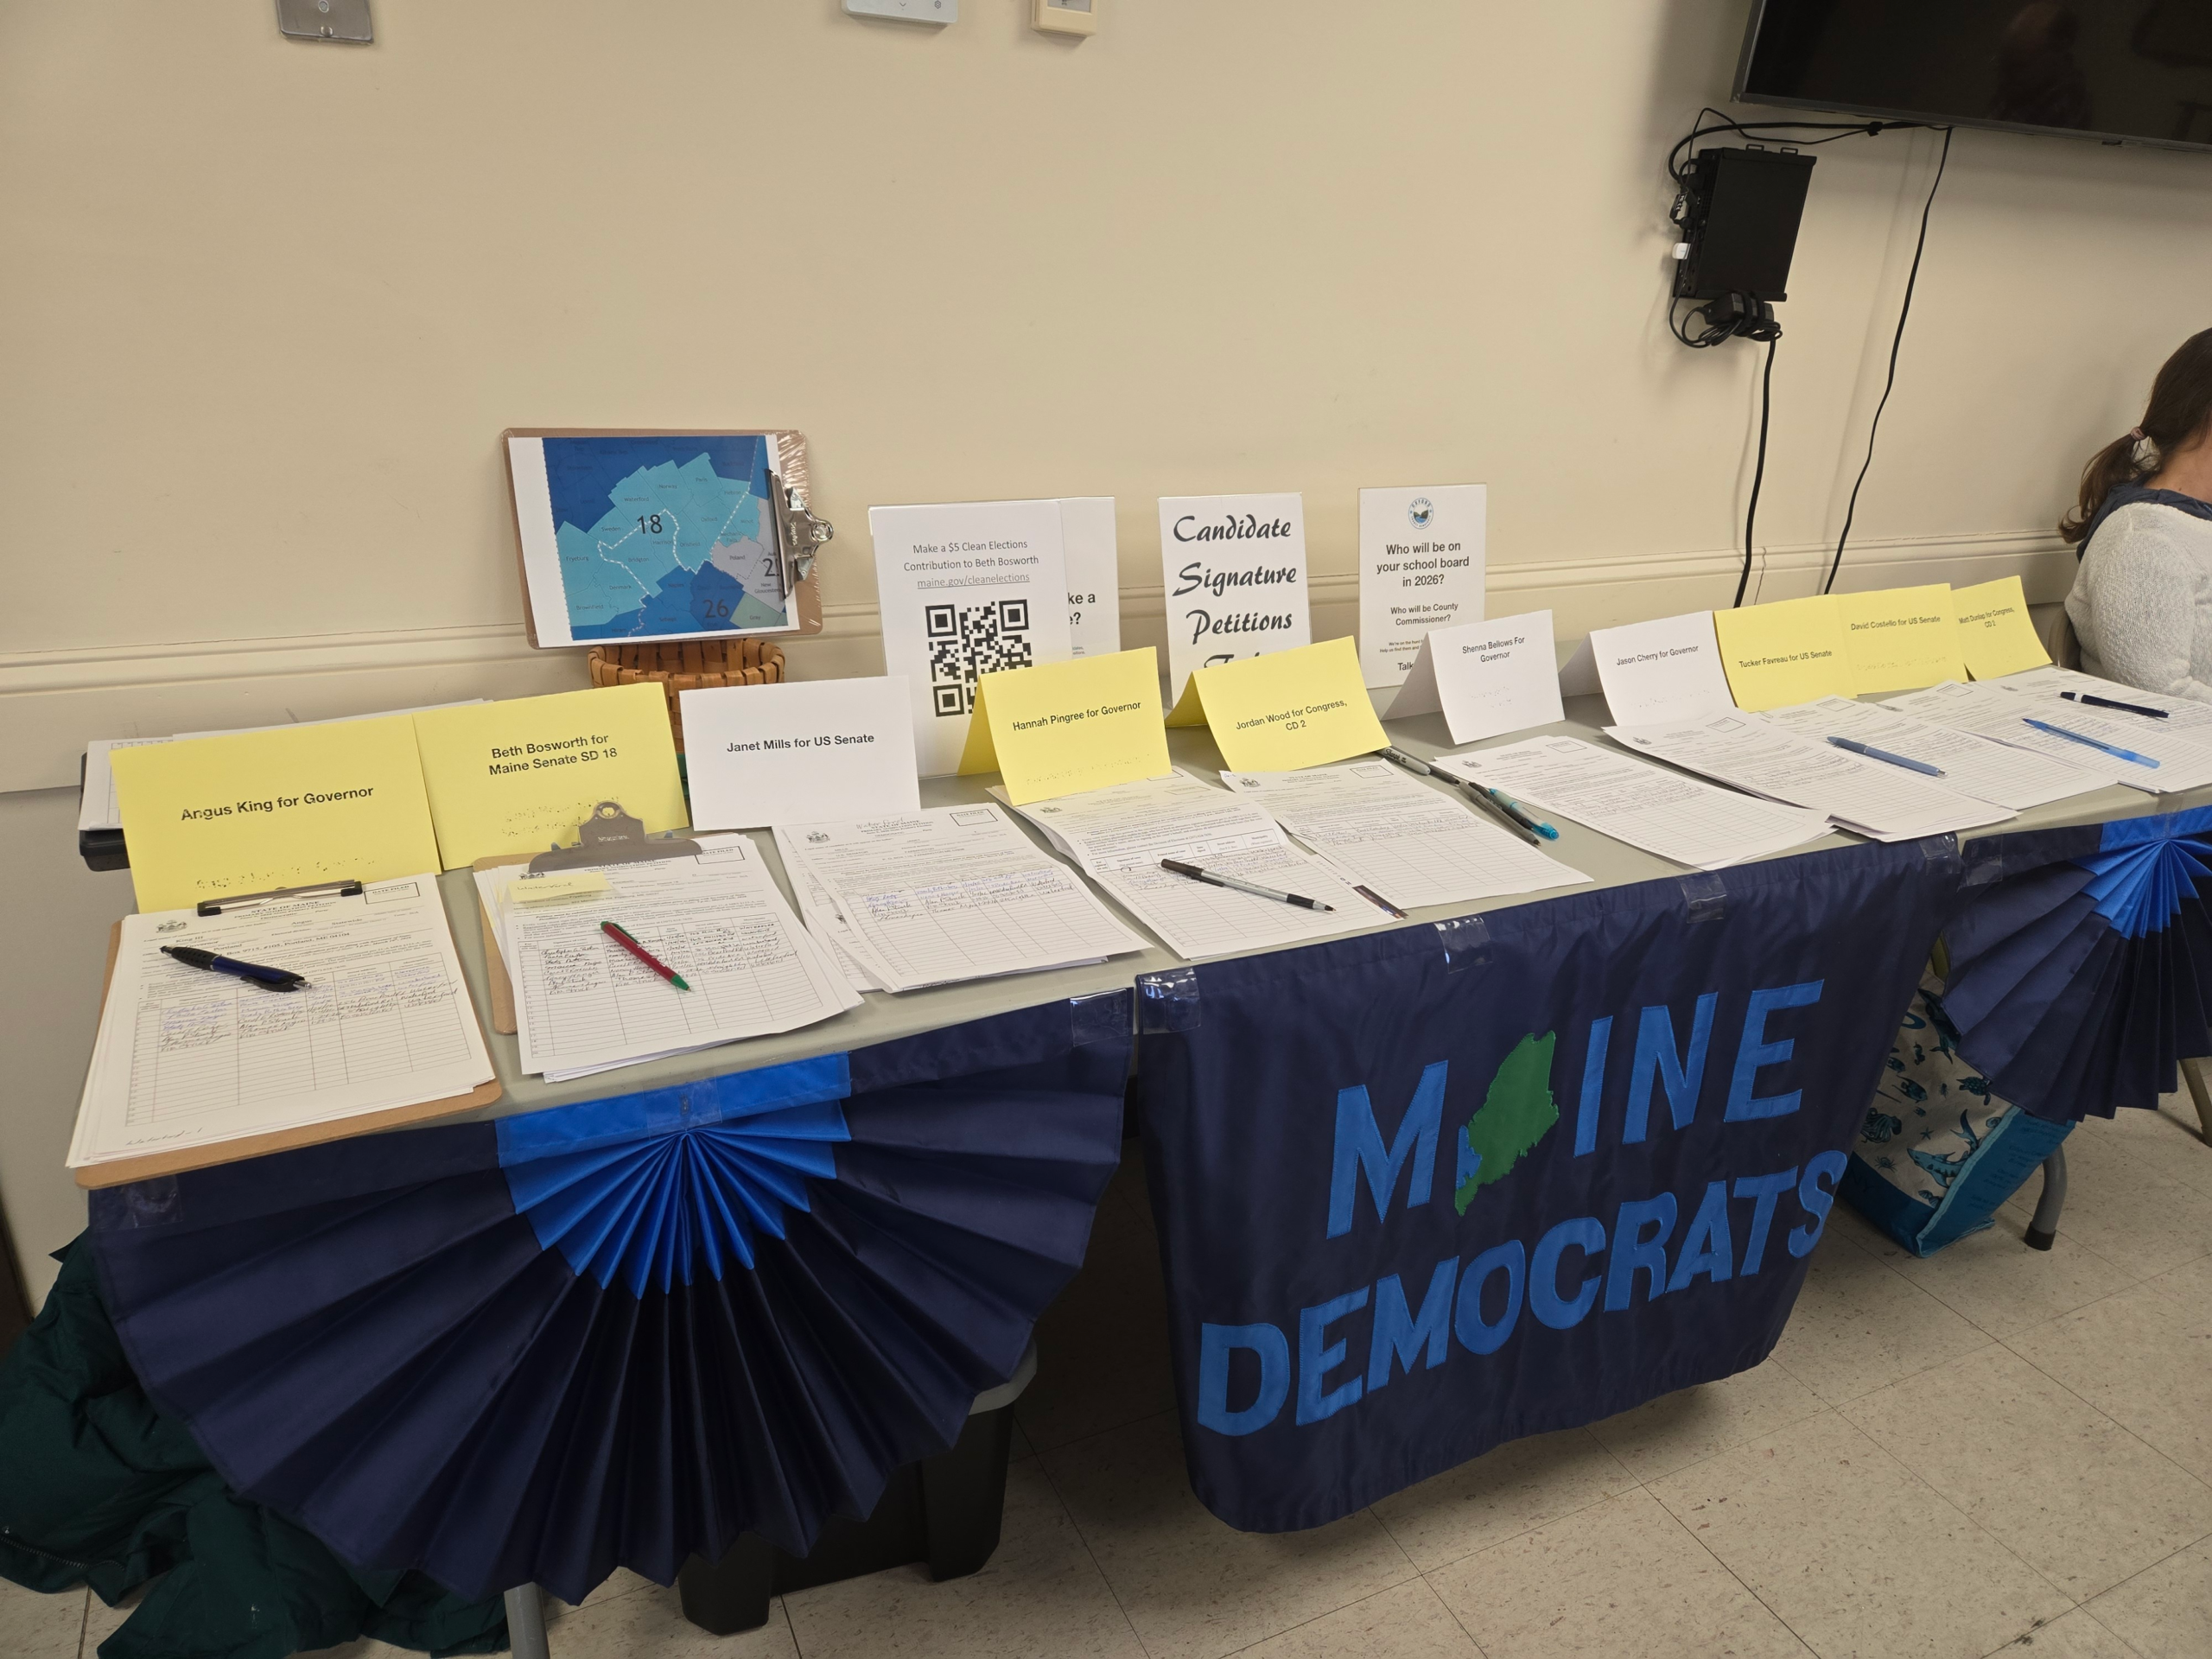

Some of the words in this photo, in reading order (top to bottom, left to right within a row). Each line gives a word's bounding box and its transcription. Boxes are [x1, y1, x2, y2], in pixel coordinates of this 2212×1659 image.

[637, 514, 663, 534] 18
[1173, 513, 1291, 542] Candidate
[912, 543, 938, 554] Make
[949, 542, 960, 553] $5
[962, 541, 987, 551] Clean
[988, 539, 1028, 550] Elections
[1386, 543, 1409, 555] Who
[1413, 543, 1429, 553] will
[1433, 542, 1446, 552] be
[1448, 543, 1461, 552] on
[904, 558, 961, 571] Contribution
[963, 559, 973, 569] to
[975, 557, 995, 568] Beth
[998, 556, 1039, 566] Bosworth
[1376, 563, 1400, 575] your
[1403, 558, 1437, 571] school
[1440, 556, 1469, 568] board
[917, 573, 1030, 588] maine.gov/cleanelections
[1173, 562, 1296, 596] Signature
[1402, 577, 1412, 588] in
[1414, 574, 1445, 587] 2026?
[1088, 594, 1096, 603] a
[1433, 603, 1459, 613] County
[702, 599, 729, 619] 26
[1969, 613, 1986, 622] Dunlap
[1992, 607, 2015, 616] Congress,
[1185, 609, 1293, 645] Petitions
[1395, 614, 1451, 626] Commissioner?
[1850, 621, 1869, 631] David
[1870, 620, 1897, 630] Costello
[1897, 618, 1907, 627] for
[1908, 617, 1918, 626] US
[1918, 615, 1941, 625] Senate
[1462, 643, 1487, 654] Shenna
[1488, 639, 1513, 651] Bellows
[1514, 636, 1525, 646] For
[1480, 652, 1510, 663] Governor
[1617, 655, 1636, 667] Jason
[1637, 652, 1659, 665] Cherry
[1660, 650, 1669, 659] for
[1669, 645, 1699, 658] Governor
[1738, 658, 1762, 668] Tucker
[1762, 655, 1788, 665] Favreau
[1789, 653, 1798, 663] for
[1799, 652, 1809, 661] US
[1810, 649, 1833, 660] Senate
[1397, 661, 1414, 671] Talk
[1013, 716, 1048, 732] Hannah
[1050, 712, 1084, 728] Pingree
[1085, 708, 1099, 719] for
[1101, 701, 1141, 716] Governor
[1236, 715, 1266, 731] Jordan
[1267, 711, 1290, 725] Wood
[1291, 707, 1304, 718] for
[1305, 700, 1348, 717] Congress,
[1285, 721, 1300, 733] CD
[1300, 720, 1307, 730] 2
[492, 746, 523, 759] Beth
[526, 736, 588, 754] Bosworth
[590, 734, 608, 746] for
[727, 741, 760, 753] Janet
[763, 739, 791, 750] Mills
[794, 737, 810, 747] for
[814, 736, 831, 747] US
[834, 734, 874, 746] Senate
[489, 761, 529, 776] Maine
[532, 753, 577, 769] Senate
[581, 750, 599, 762] SD
[602, 747, 618, 759] 18
[181, 805, 232, 821] Angus
[237, 800, 273, 813] King
[277, 796, 299, 808] for
[303, 787, 374, 804] Governor
[284, 938, 315, 947] Portland,
[1326, 978, 1825, 1239] MINE
[1198, 1150, 1848, 1436] DEMOCRATS
